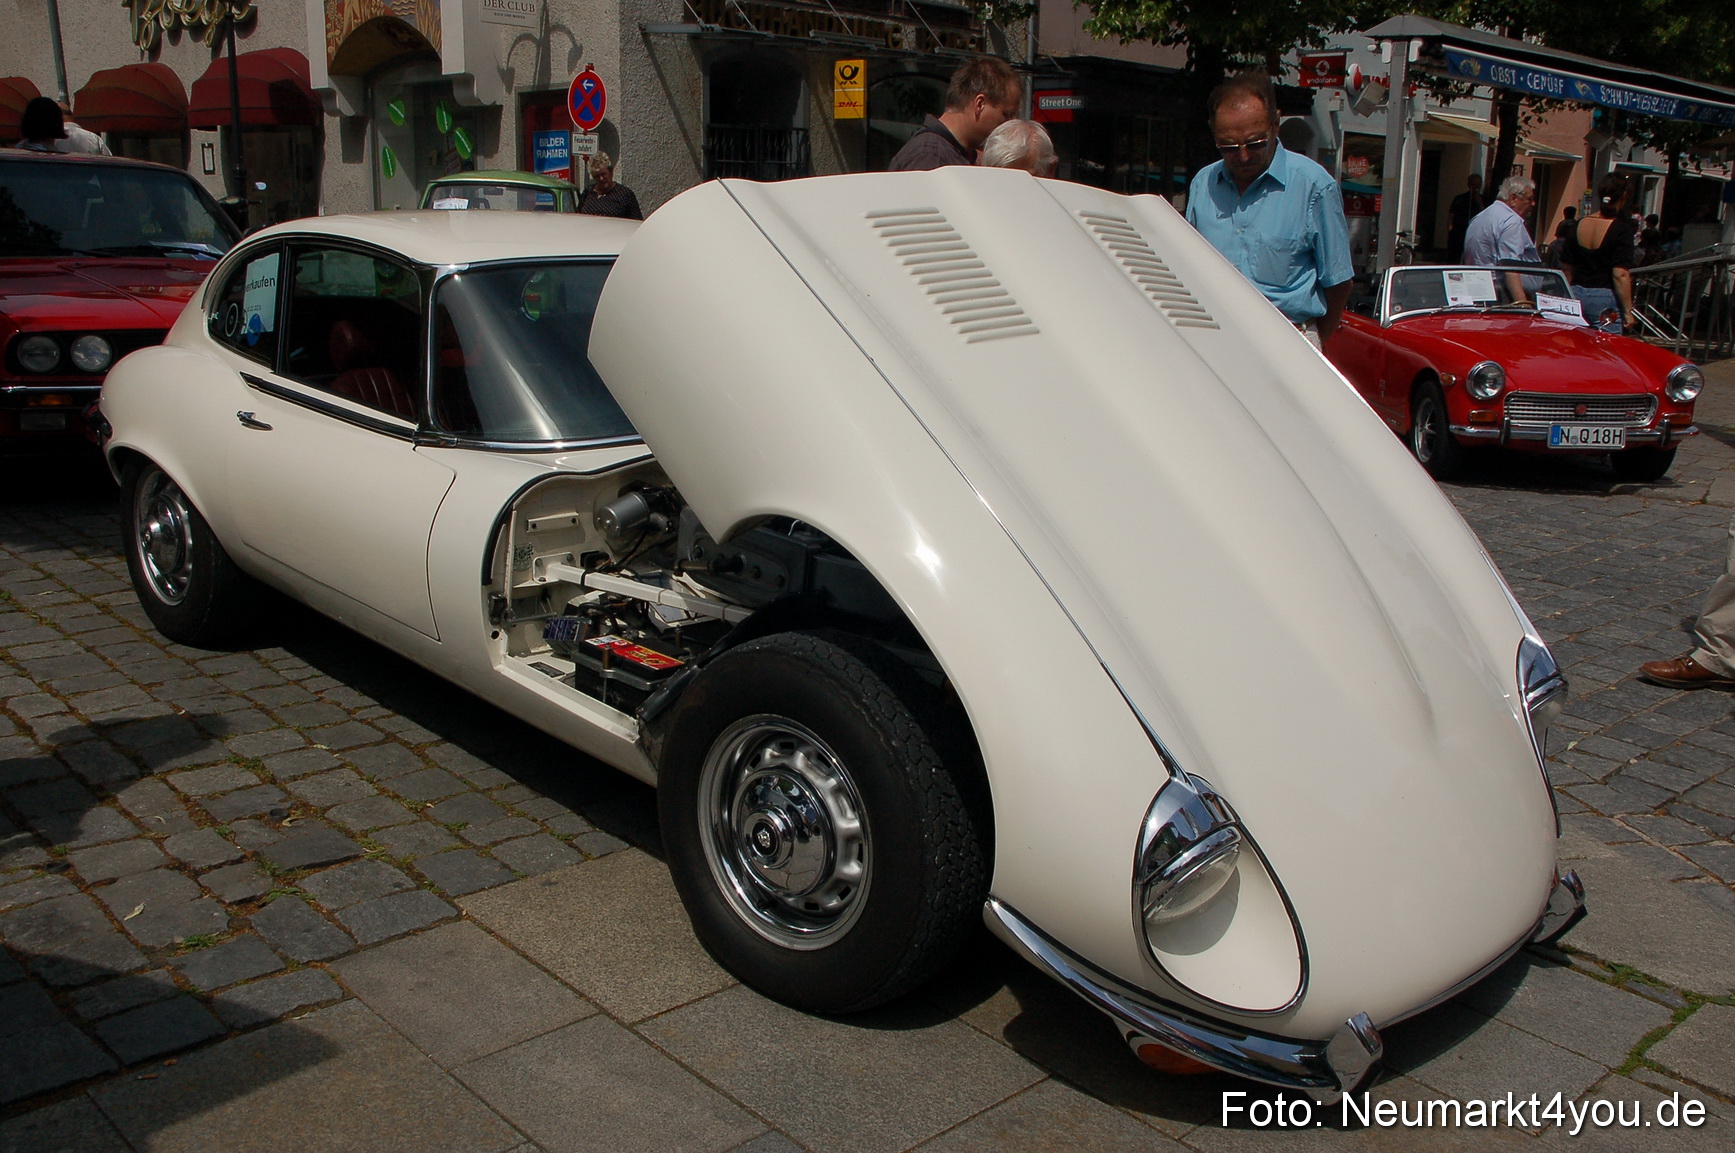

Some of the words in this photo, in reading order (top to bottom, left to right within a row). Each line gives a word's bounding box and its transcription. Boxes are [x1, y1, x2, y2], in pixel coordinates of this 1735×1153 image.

[484, 0, 506, 10] DER
[507, 1, 536, 13] CLUB
[1490, 64, 1516, 86] OBST
[1306, 77, 1338, 85] vodafone
[1041, 98, 1065, 107] Street
[1066, 97, 1082, 107] One
[539, 137, 565, 147] BILDER
[536, 149, 568, 159] RAHMEN
[1560, 428, 1570, 443] N
[1579, 428, 1623, 445] Q18H
